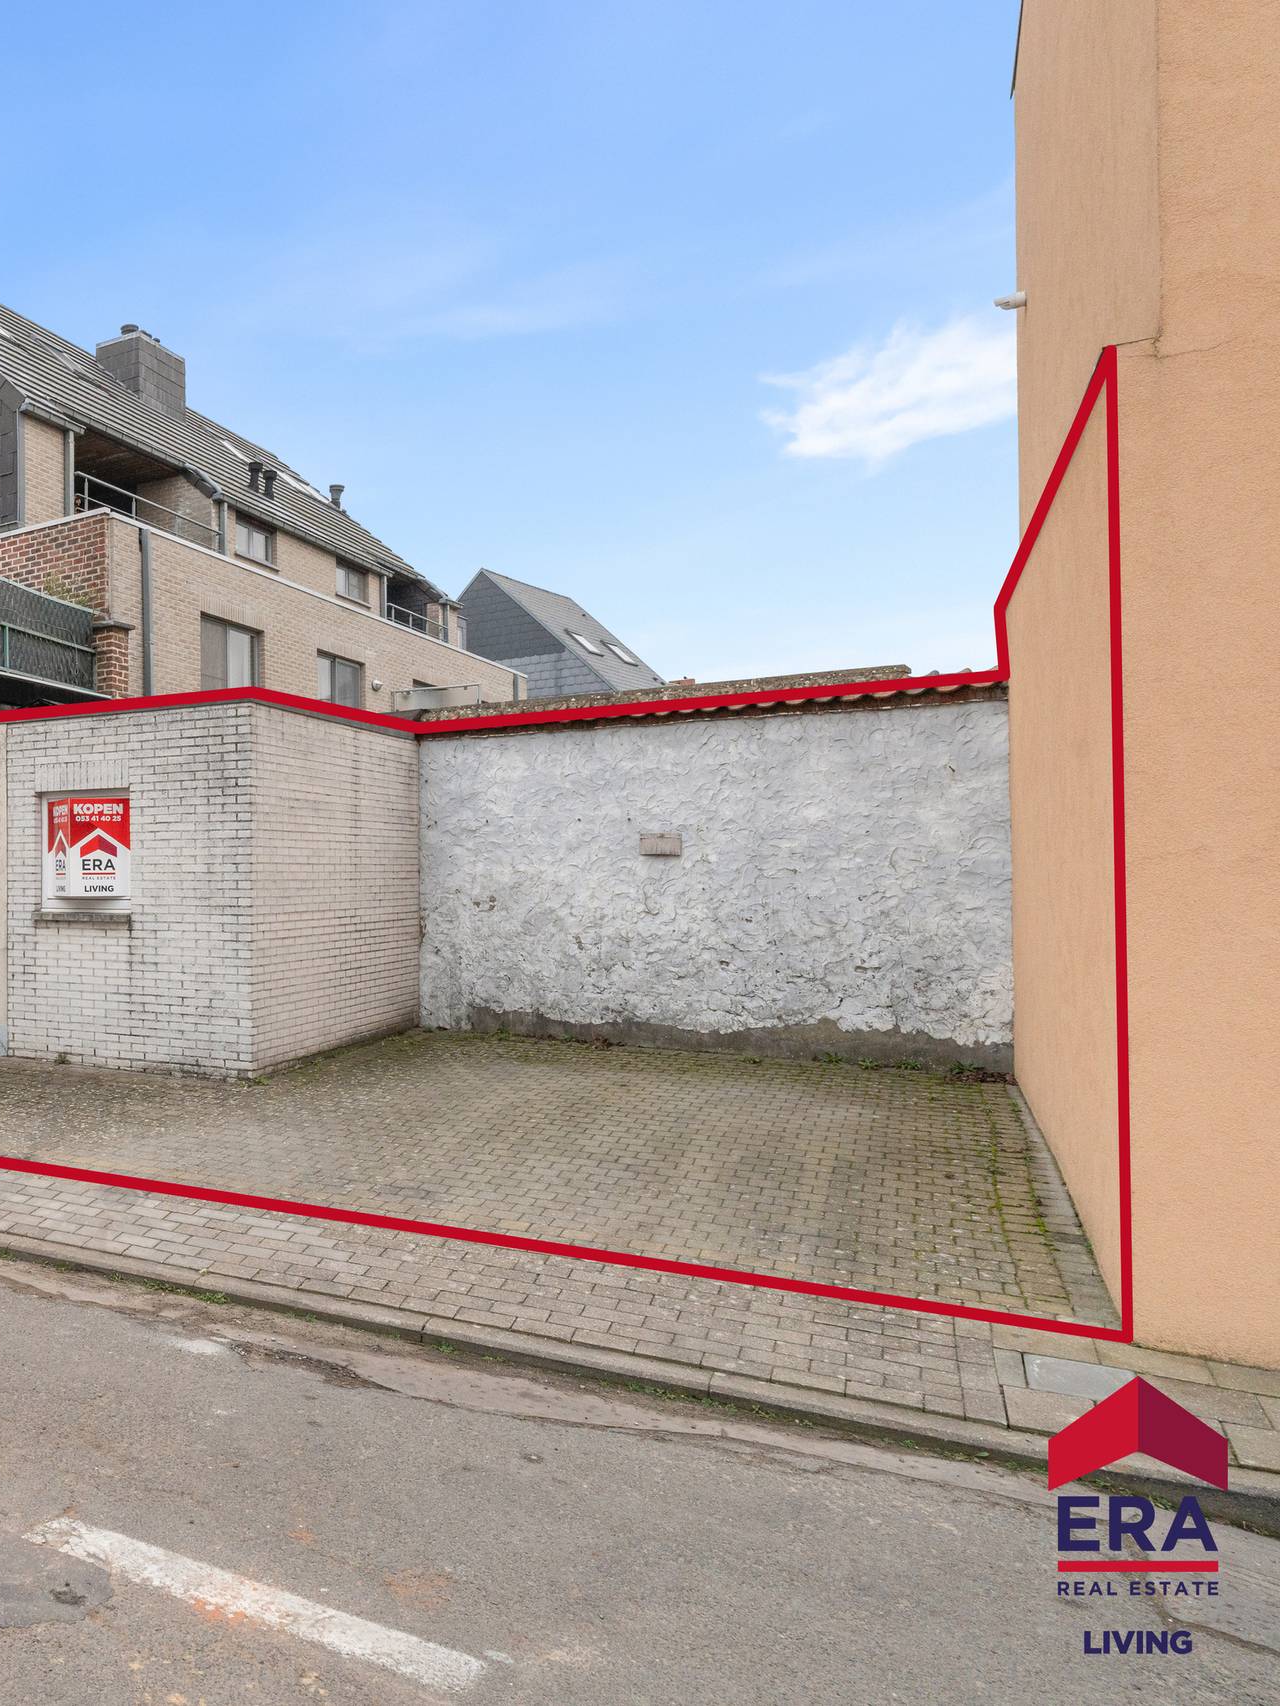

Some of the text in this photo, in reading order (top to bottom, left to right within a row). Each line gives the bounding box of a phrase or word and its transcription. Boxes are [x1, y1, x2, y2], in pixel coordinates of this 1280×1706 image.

[73, 803, 124, 815] KOPEN
[81, 858, 116, 871] ERA
[84, 885, 115, 893] LIVING
